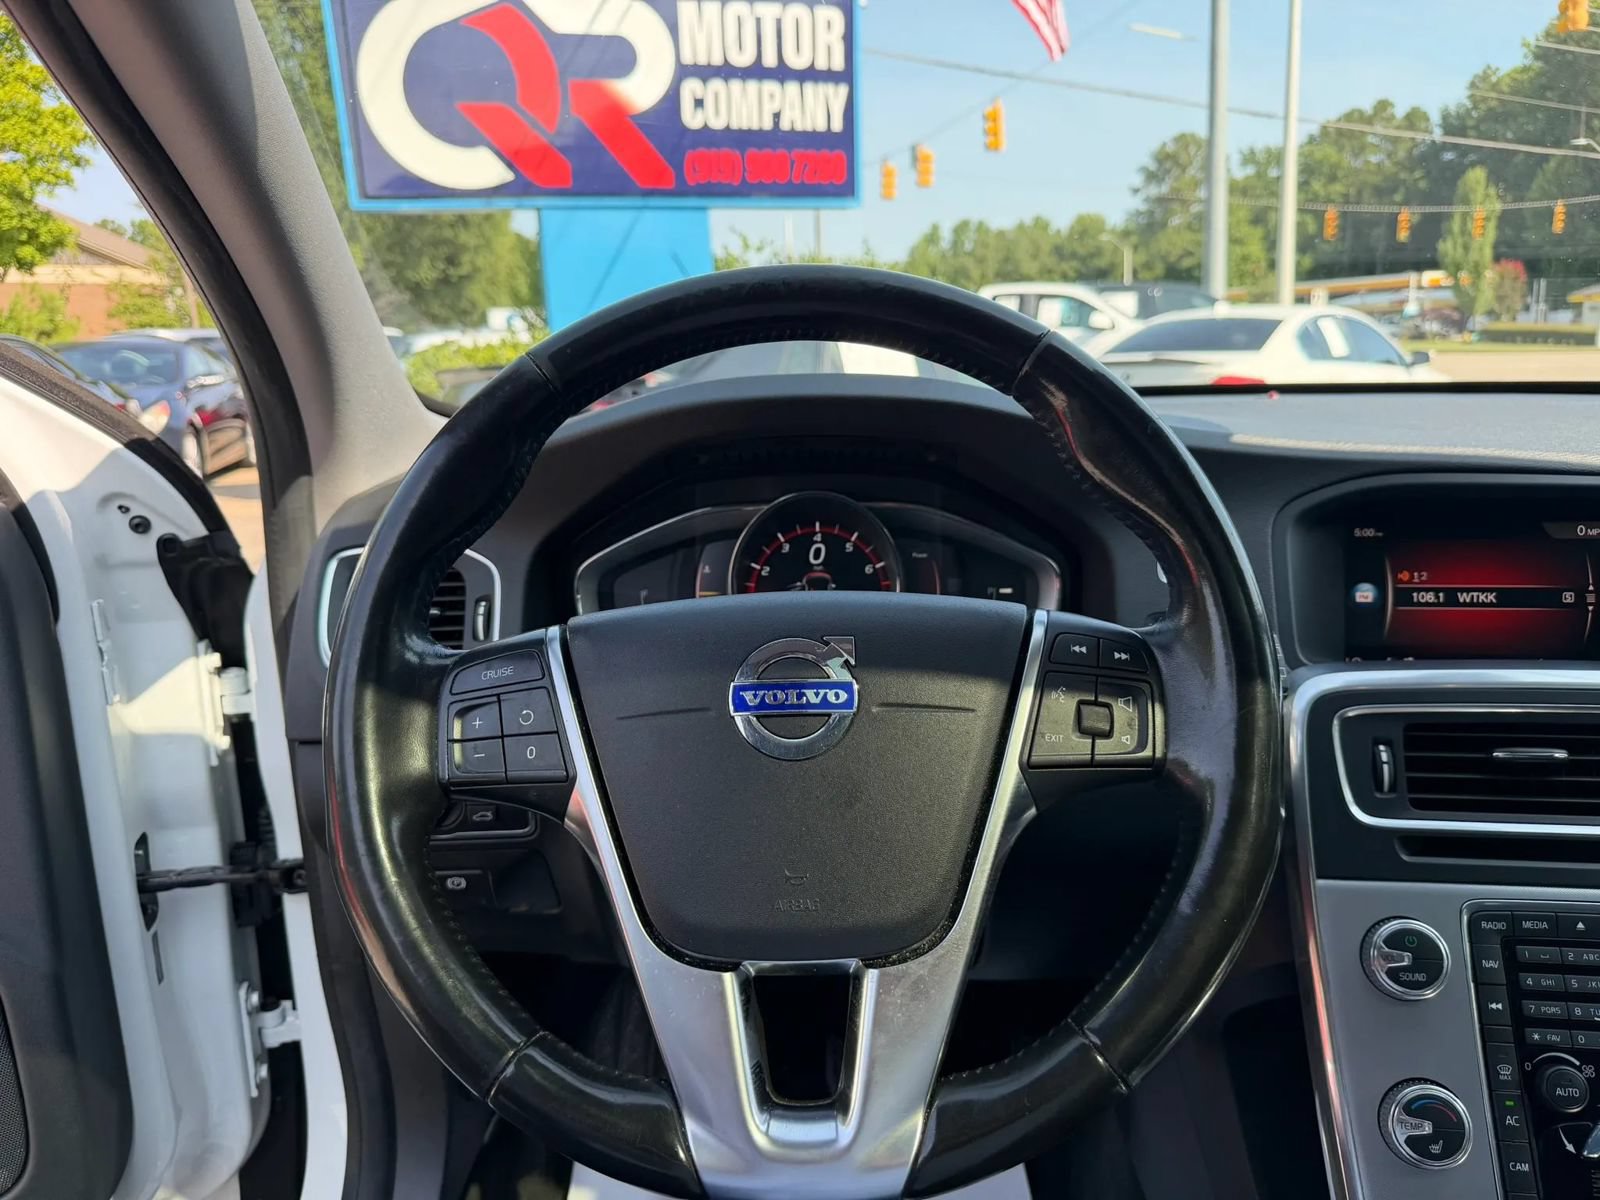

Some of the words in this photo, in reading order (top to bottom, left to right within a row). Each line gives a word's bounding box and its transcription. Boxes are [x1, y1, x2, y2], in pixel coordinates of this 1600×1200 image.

[677, 0, 846, 71] MOTOR
[679, 77, 850, 133] COMPANY
[813, 533, 822, 542] 4
[782, 543, 790, 553] 3
[845, 542, 854, 552] 5
[809, 543, 826, 565] 0
[761, 566, 770, 576] 2
[865, 564, 874, 575] 6
[1457, 592, 1497, 603] WTKK
[481, 665, 514, 680] CRUISE
[740, 688, 848, 706] VOLVO
[1045, 734, 1064, 743] EXIT
[526, 746, 536, 759] 0
[775, 898, 820, 912] AIRBAG
[1481, 921, 1506, 930] RADIO
[1522, 920, 1549, 930] MEDIA
[1568, 952, 1574, 960] 2
[1482, 959, 1499, 969] NAV
[1399, 972, 1427, 981] SOUND
[1526, 977, 1533, 985] 4
[1571, 980, 1578, 988] 5
[1529, 1005, 1536, 1013] 7
[1541, 1006, 1561, 1014] PQRS
[1574, 1007, 1582, 1016] 8
[1547, 1034, 1561, 1042] FAV
[1578, 1035, 1585, 1044] 0
[1555, 1087, 1580, 1097] AUTO
[1505, 1115, 1520, 1126] AC
[1400, 1121, 1423, 1131] TEMP
[1509, 1162, 1530, 1171] CAM
